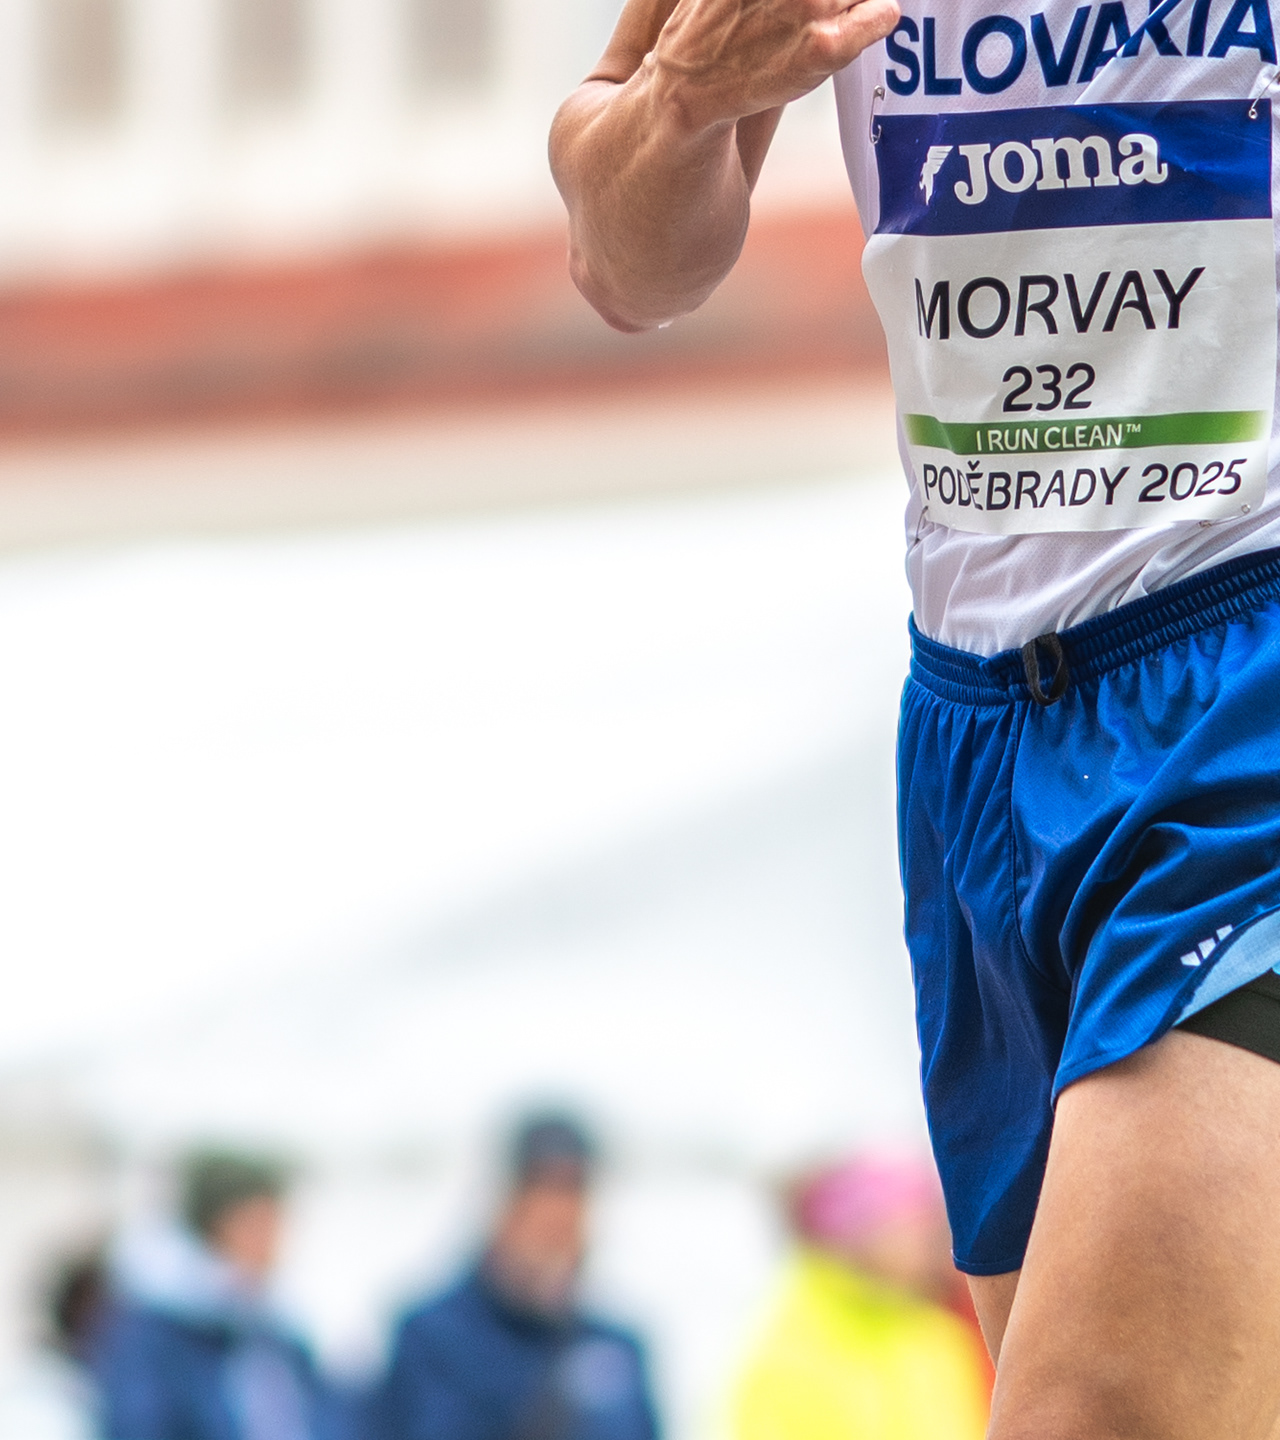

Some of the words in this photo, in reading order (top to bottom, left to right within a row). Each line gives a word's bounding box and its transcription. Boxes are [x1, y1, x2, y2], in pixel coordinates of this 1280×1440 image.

[914, 266, 1206, 341] MORVAY
[1001, 362, 1096, 412] 232
[975, 430, 983, 452] I
[987, 426, 1038, 451] RUN
[922, 459, 1131, 511] PODĚBRADY
[1138, 458, 1248, 503] 2025
